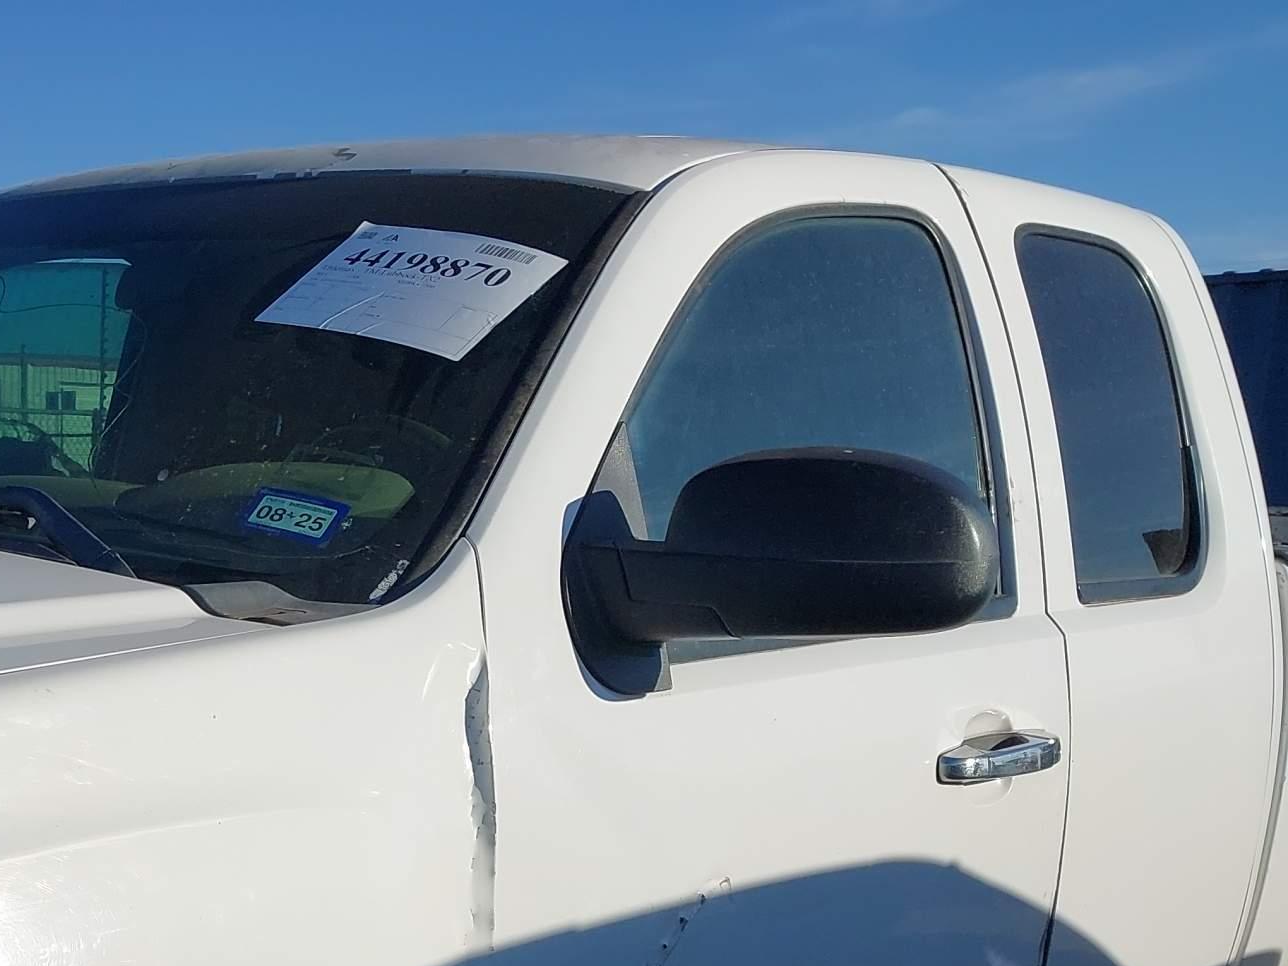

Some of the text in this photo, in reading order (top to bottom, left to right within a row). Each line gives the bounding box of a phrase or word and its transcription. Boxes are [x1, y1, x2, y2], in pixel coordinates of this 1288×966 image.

[344, 248, 512, 287] 44198870
[255, 504, 287, 523] 08
[294, 513, 327, 532] 25
